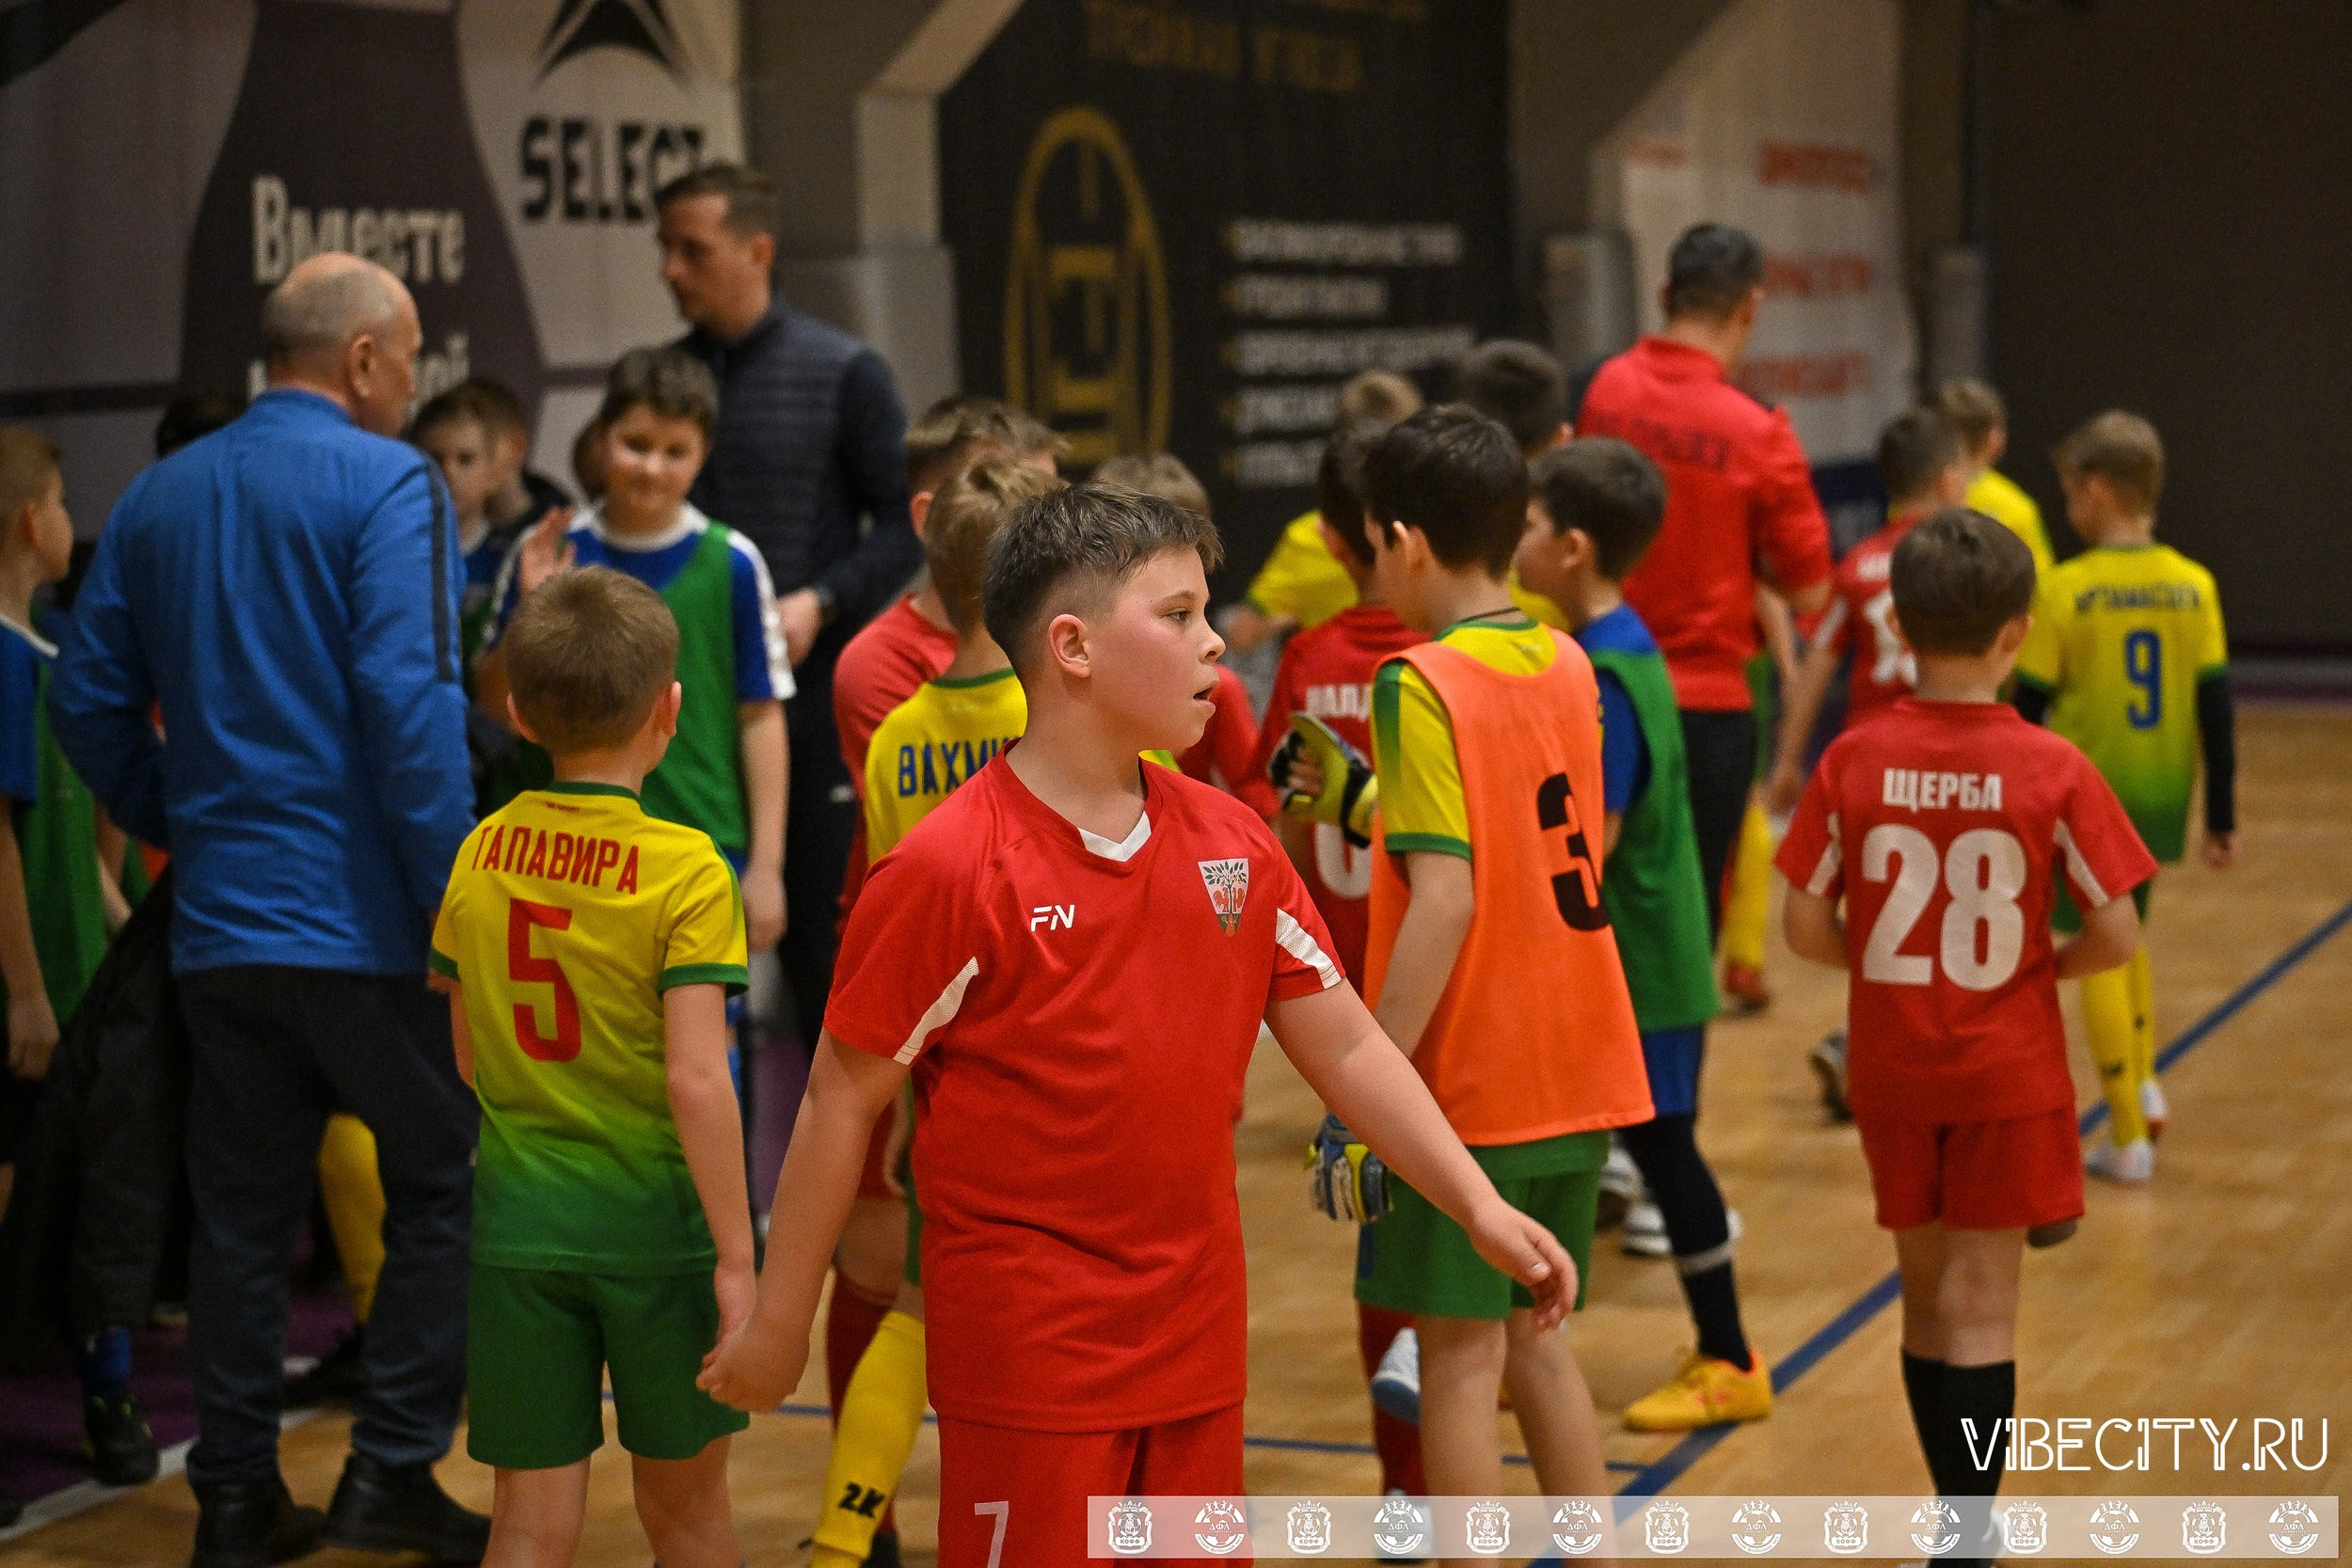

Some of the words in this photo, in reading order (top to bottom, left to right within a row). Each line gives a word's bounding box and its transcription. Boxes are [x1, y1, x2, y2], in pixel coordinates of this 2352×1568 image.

[2125, 628, 2162, 731] 9
[1883, 767, 2003, 814] ЩЕРБА
[1537, 771, 1609, 931] 3
[1030, 904, 1075, 932] FN
[1861, 822, 2027, 992] 28
[506, 897, 582, 1062] 5
[974, 1500, 1010, 1568] 7
